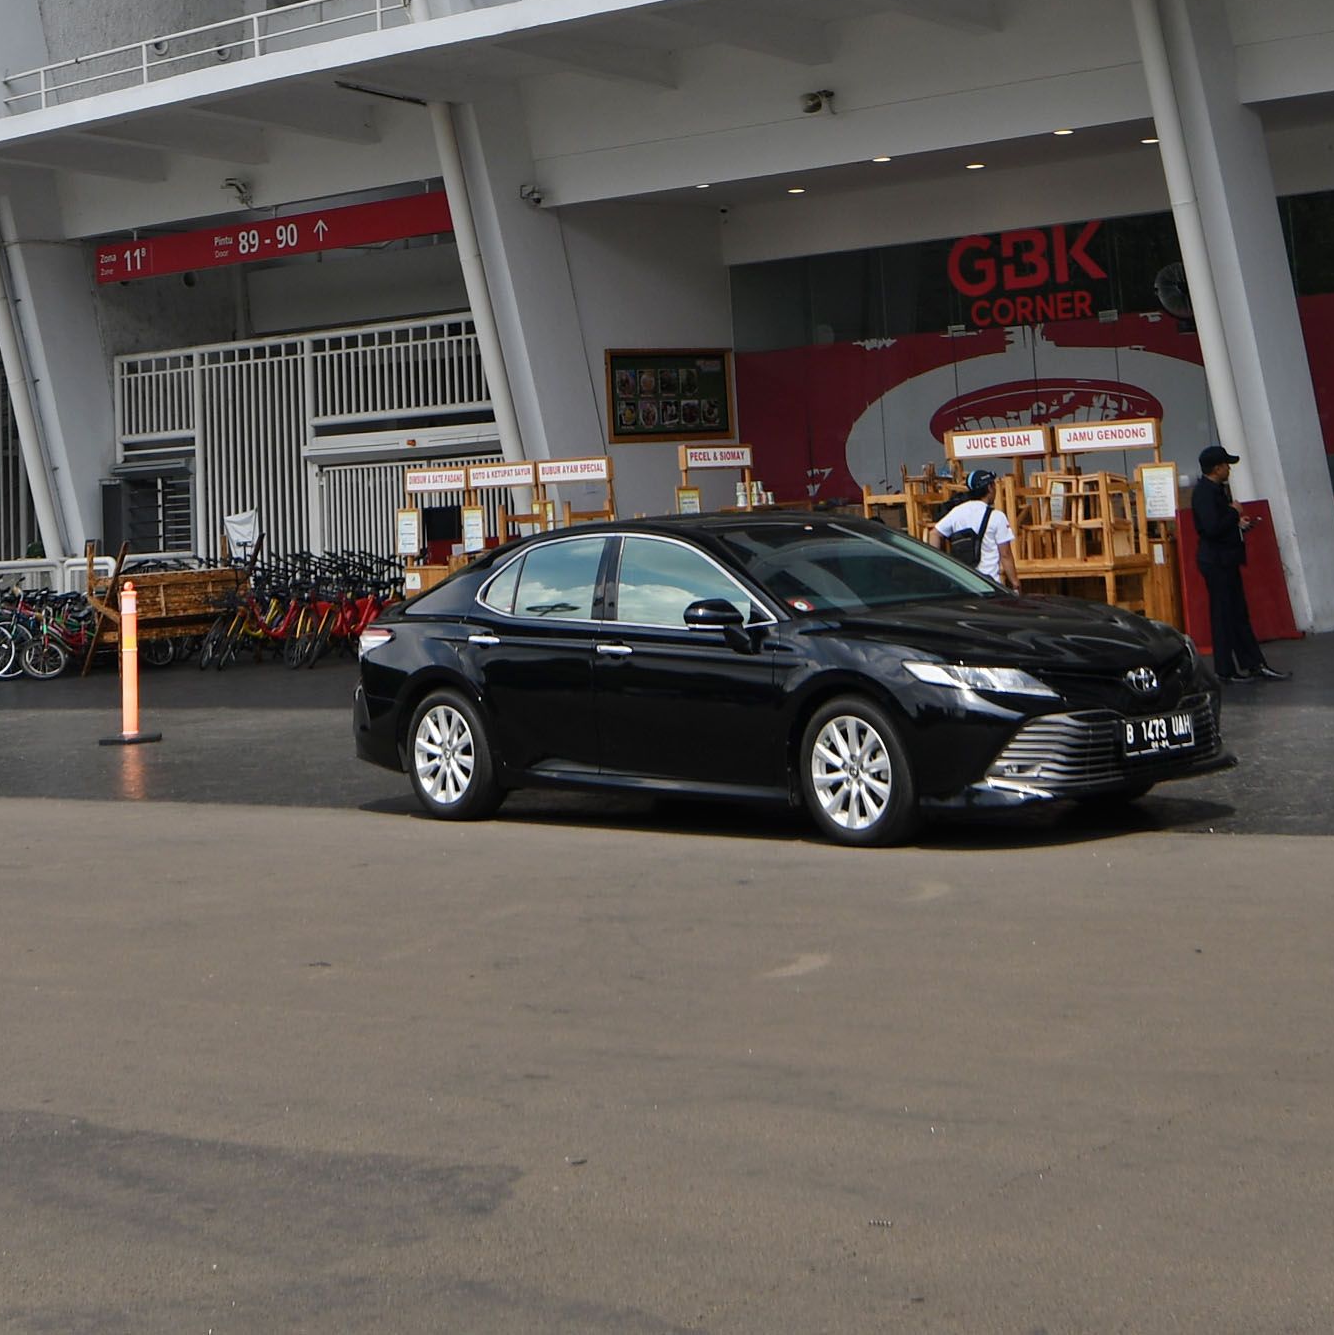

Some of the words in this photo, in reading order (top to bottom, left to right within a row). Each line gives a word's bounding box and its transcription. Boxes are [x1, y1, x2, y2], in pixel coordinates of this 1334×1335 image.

[214, 235, 233, 247] Pintu
[238, 230, 259, 254] 89
[276, 223, 299, 248] 90
[100, 252, 117, 264] Zona
[947, 220, 1107, 297] GBK
[970, 290, 1093, 326] CORNER
[966, 436, 998, 450] JUICE
[1000, 434, 1031, 448] BUAH
[1066, 430, 1094, 443] JAMU
[1097, 427, 1147, 441] GENDONG
[690, 452, 711, 461] PECEL
[720, 451, 745, 461] SIOMAY
[541, 465, 561, 475] BUBUR
[562, 464, 578, 474] AYAM
[579, 462, 603, 473] SPECIAL
[432, 474, 444, 483] SATE
[1126, 723, 1134, 745] B
[1141, 718, 1167, 741] 1473
